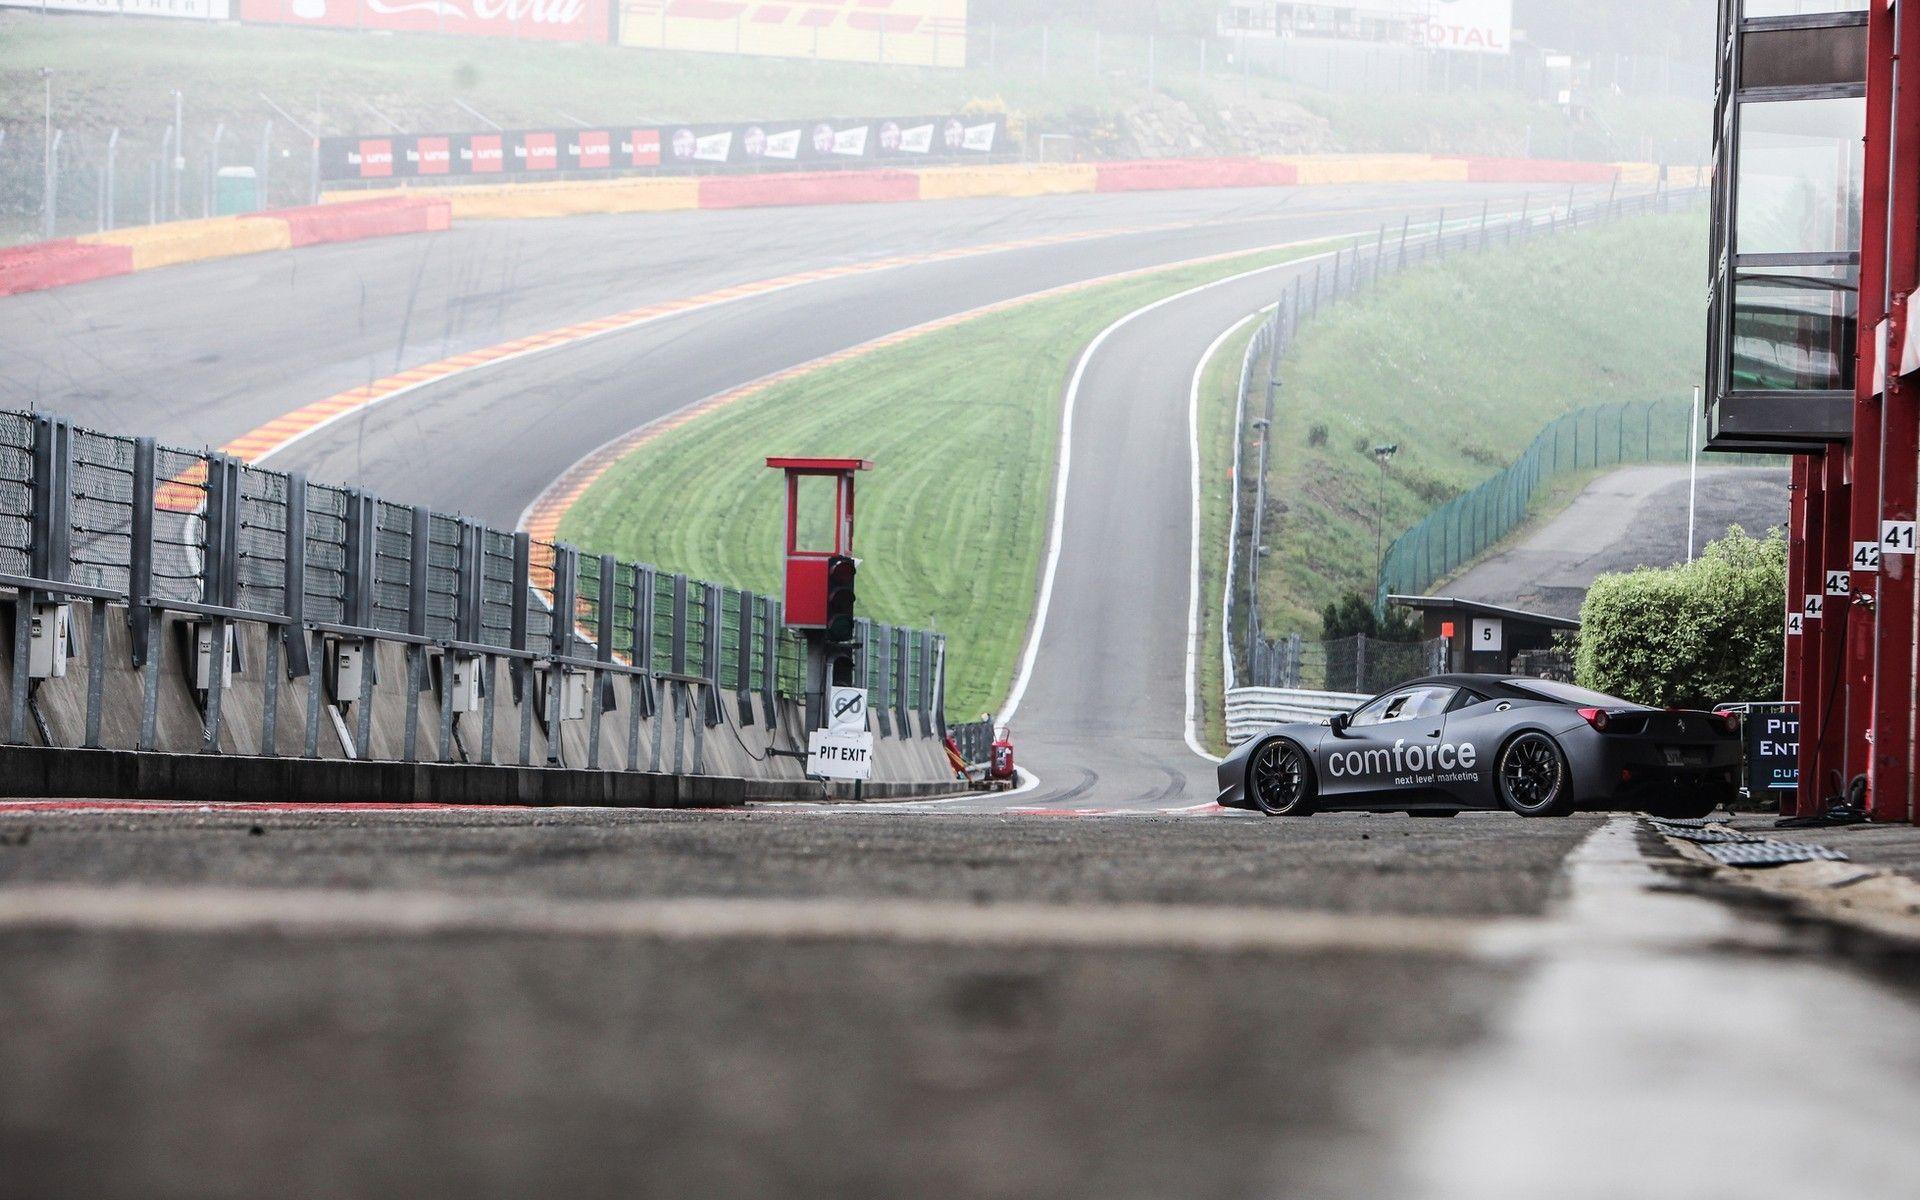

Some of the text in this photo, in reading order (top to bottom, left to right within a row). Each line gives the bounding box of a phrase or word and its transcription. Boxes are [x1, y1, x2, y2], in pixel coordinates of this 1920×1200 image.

[1884, 526, 1914, 549] 41
[1854, 546, 1879, 566] 42
[1826, 574, 1850, 593] 43
[1789, 616, 1803, 631] 4
[1483, 627, 1492, 641] 5
[835, 697, 862, 714] 60
[820, 745, 867, 762] PIT EXIT
[1329, 738, 1476, 777] comforce
[1395, 772, 1479, 785] next level marketing
